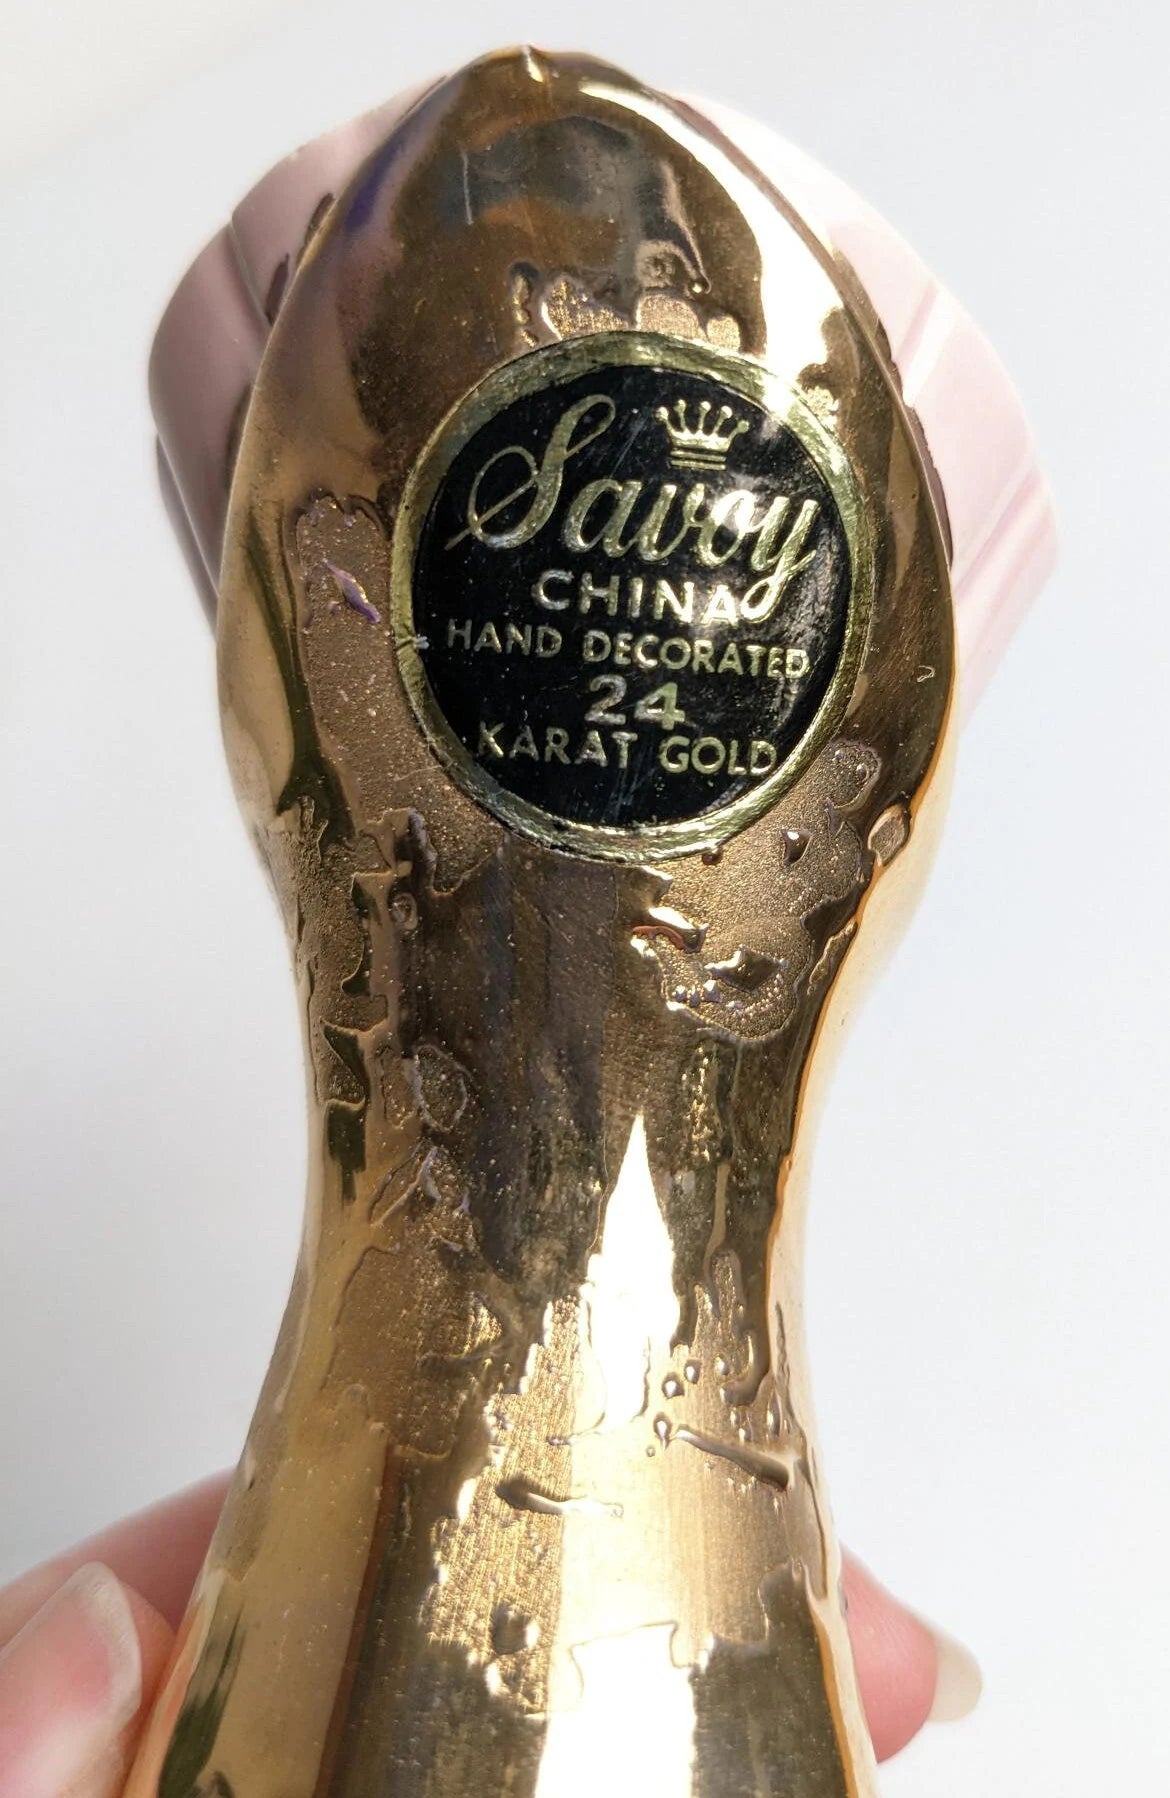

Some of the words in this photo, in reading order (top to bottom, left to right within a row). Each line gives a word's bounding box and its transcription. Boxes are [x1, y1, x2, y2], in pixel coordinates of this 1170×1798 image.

[444, 394, 822, 622] Savoy
[531, 568, 740, 627] CHINA
[446, 618, 563, 658] HAND
[582, 629, 811, 680] DECORATED
[583, 673, 687, 731] 24
[476, 720, 639, 770] KARAT
[658, 735, 778, 776] GOLD
